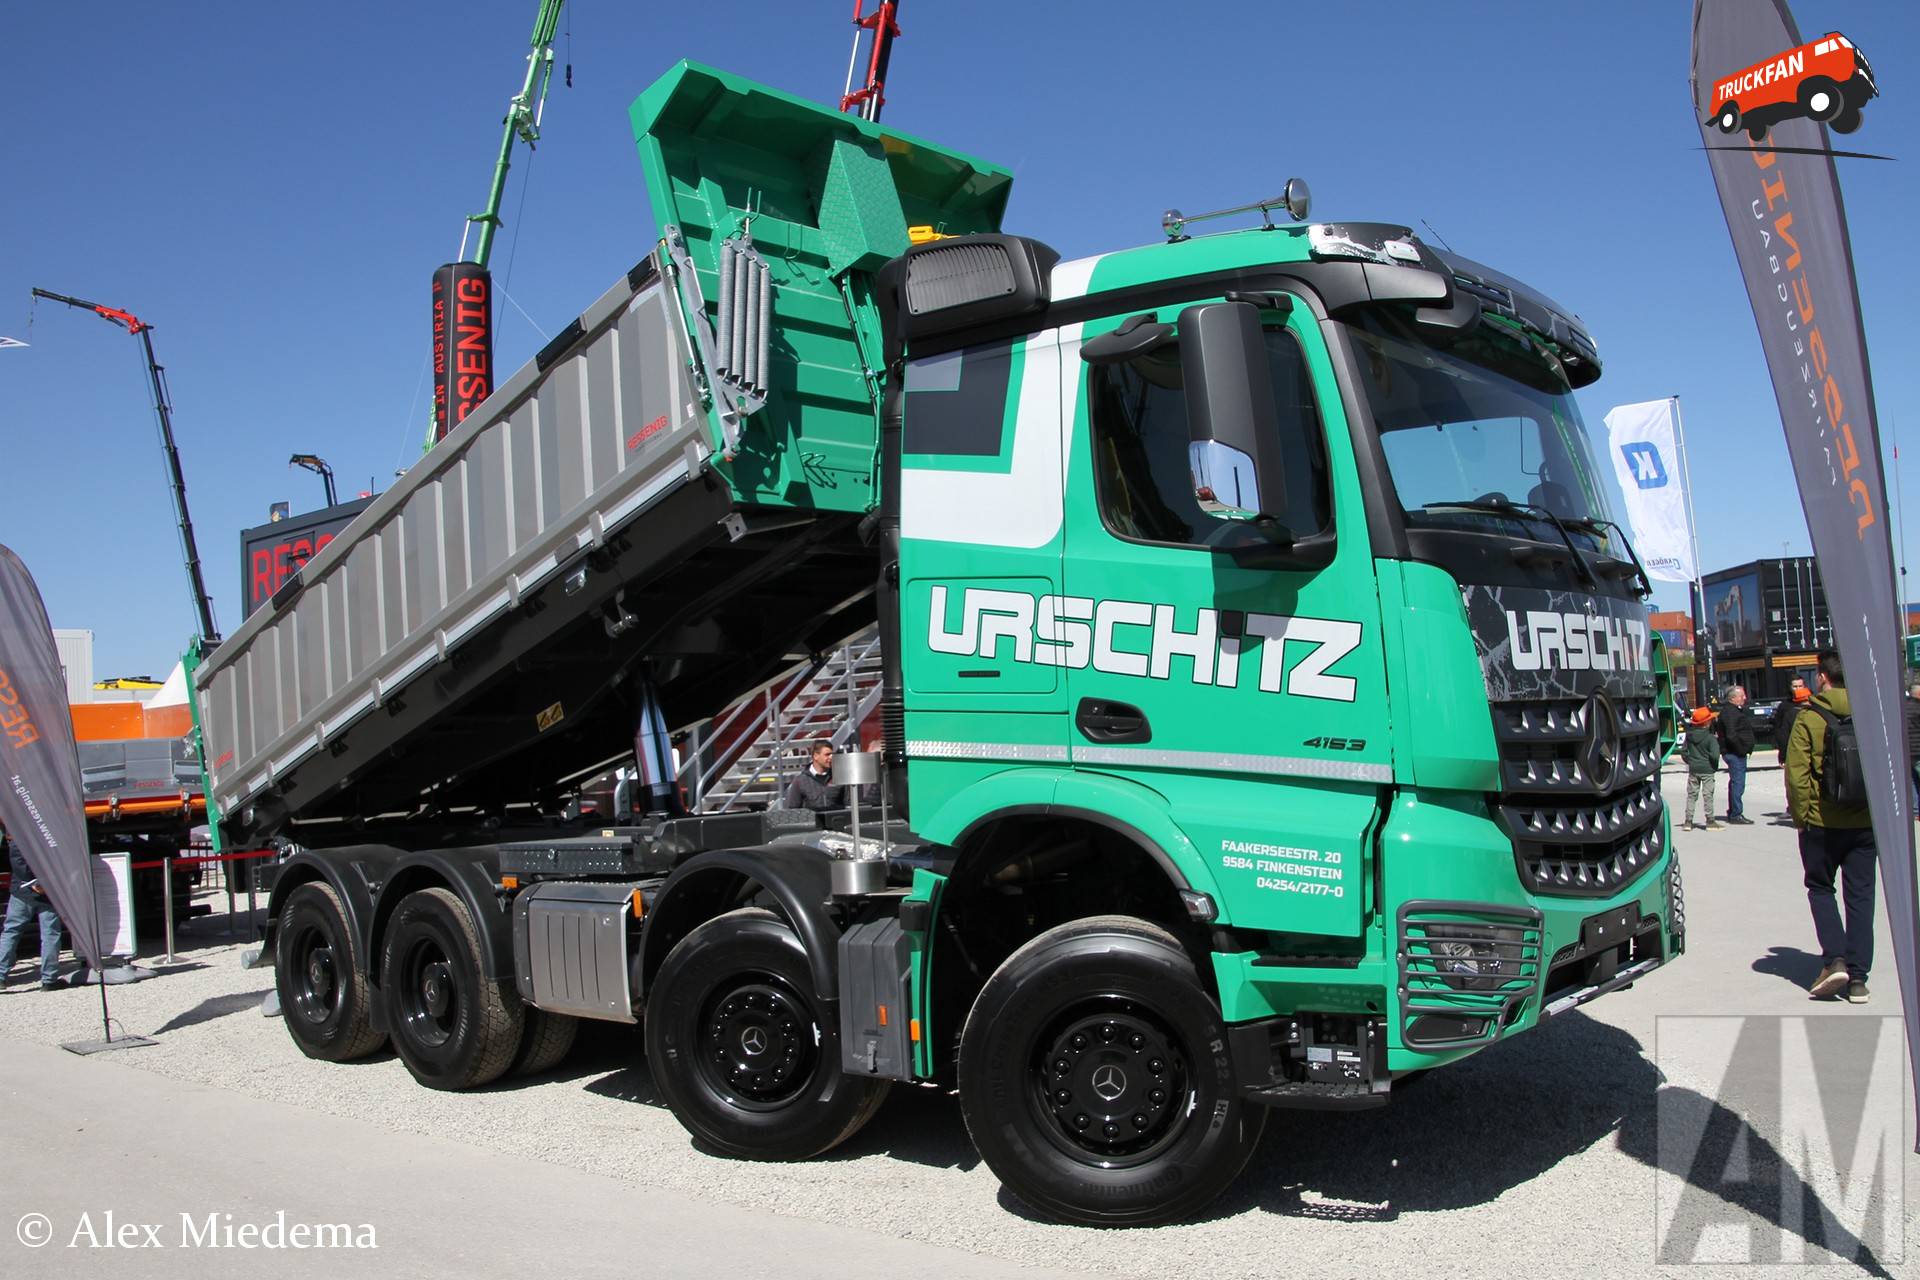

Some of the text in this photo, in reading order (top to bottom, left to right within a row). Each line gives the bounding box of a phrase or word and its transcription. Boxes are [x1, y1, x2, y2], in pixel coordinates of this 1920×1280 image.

[435, 300, 444, 373] AUSTRIA
[1221, 839, 1342, 864] FAAKERSEESTR. 20
[1222, 855, 1343, 880] 9584 FINKENSTEIN
[1256, 876, 1344, 898] 04254/2177-0
